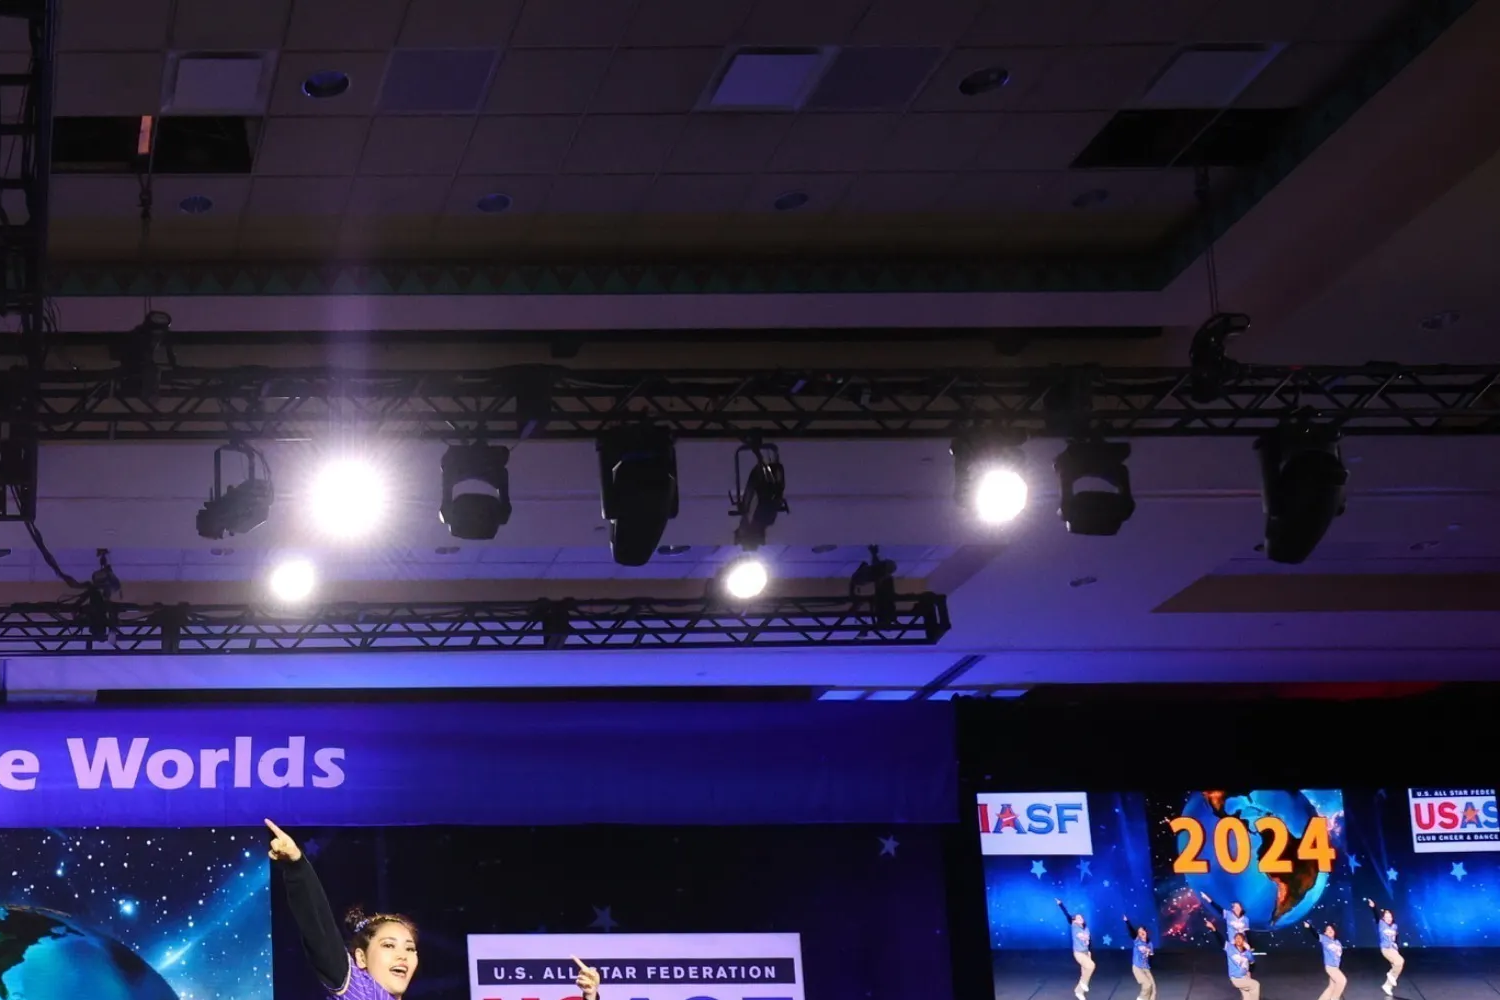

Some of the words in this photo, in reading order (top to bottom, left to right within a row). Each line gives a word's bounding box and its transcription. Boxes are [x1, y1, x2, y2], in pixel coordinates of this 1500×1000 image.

[66, 736, 345, 790] Worlds
[977, 803, 1083, 835] IASF
[1170, 815, 1337, 874] 2024
[493, 967, 533, 980] U.S.
[543, 966, 577, 980] ALL
[591, 966, 637, 979] TAR
[646, 965, 777, 979] FEDERATION
